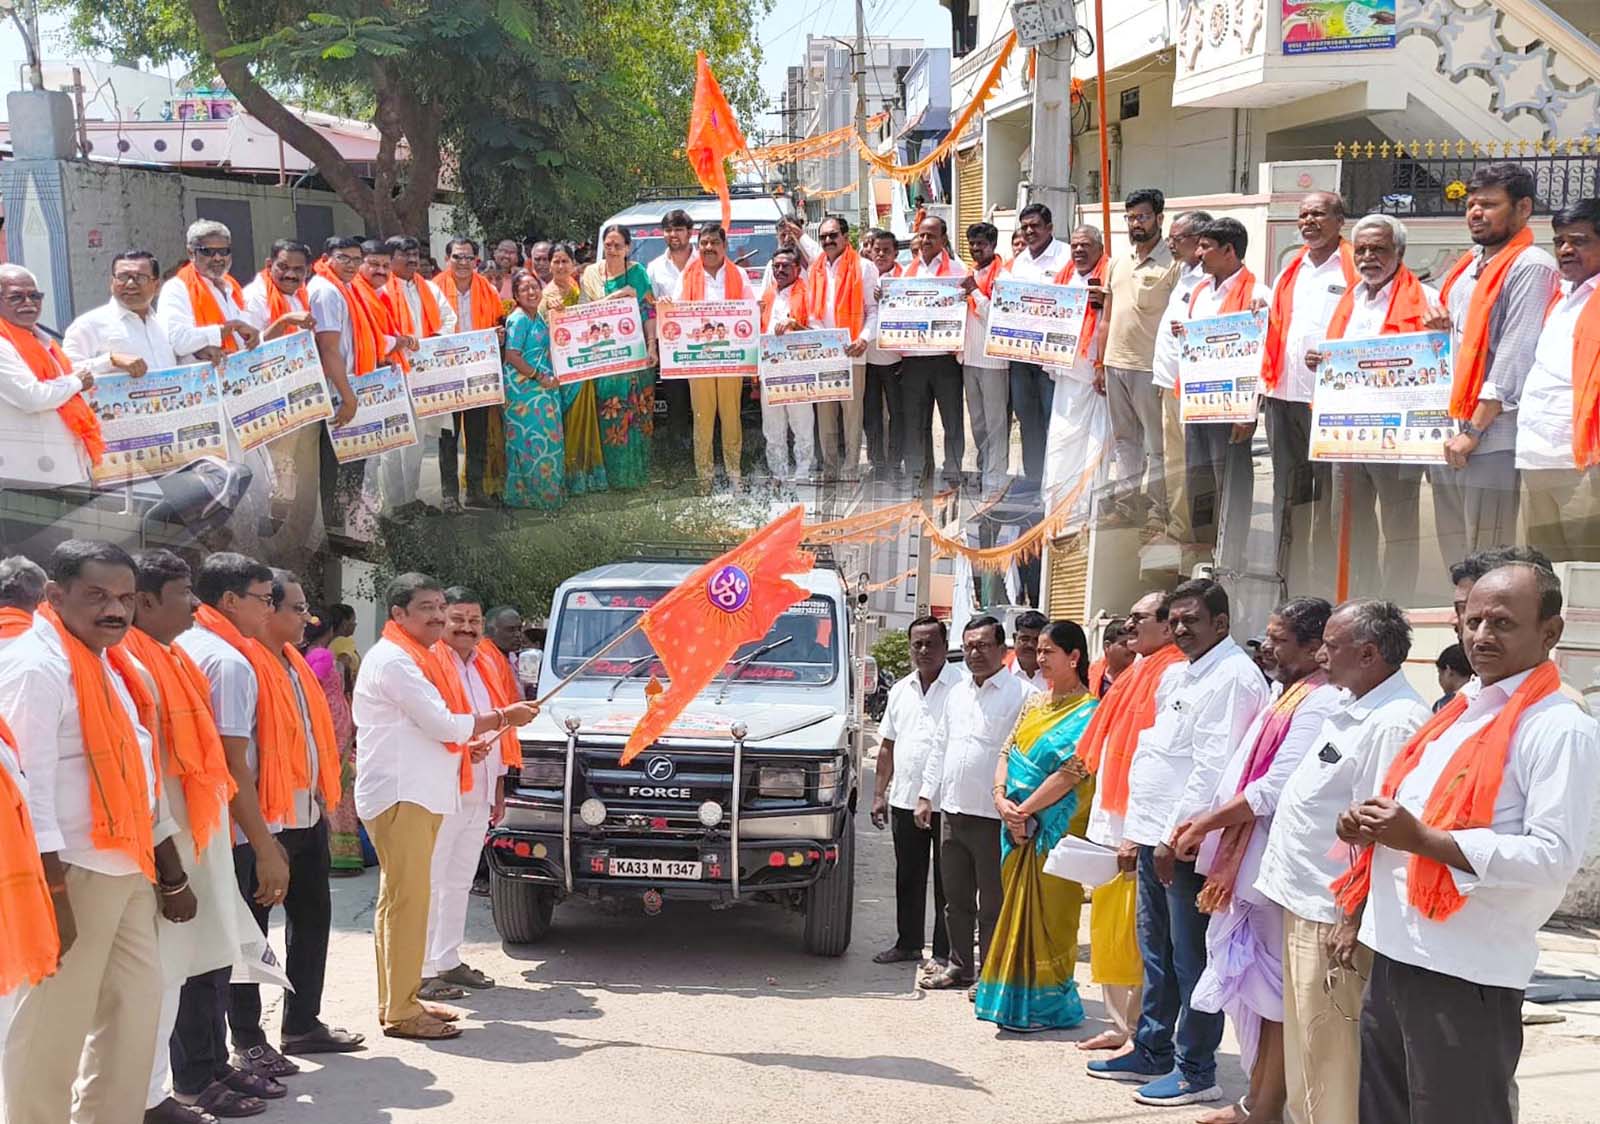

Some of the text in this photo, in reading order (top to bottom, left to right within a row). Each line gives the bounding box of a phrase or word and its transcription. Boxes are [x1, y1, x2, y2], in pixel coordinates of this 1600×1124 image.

[629, 786, 691, 798] FORCE
[616, 861, 696, 876] KA33 M 1347
